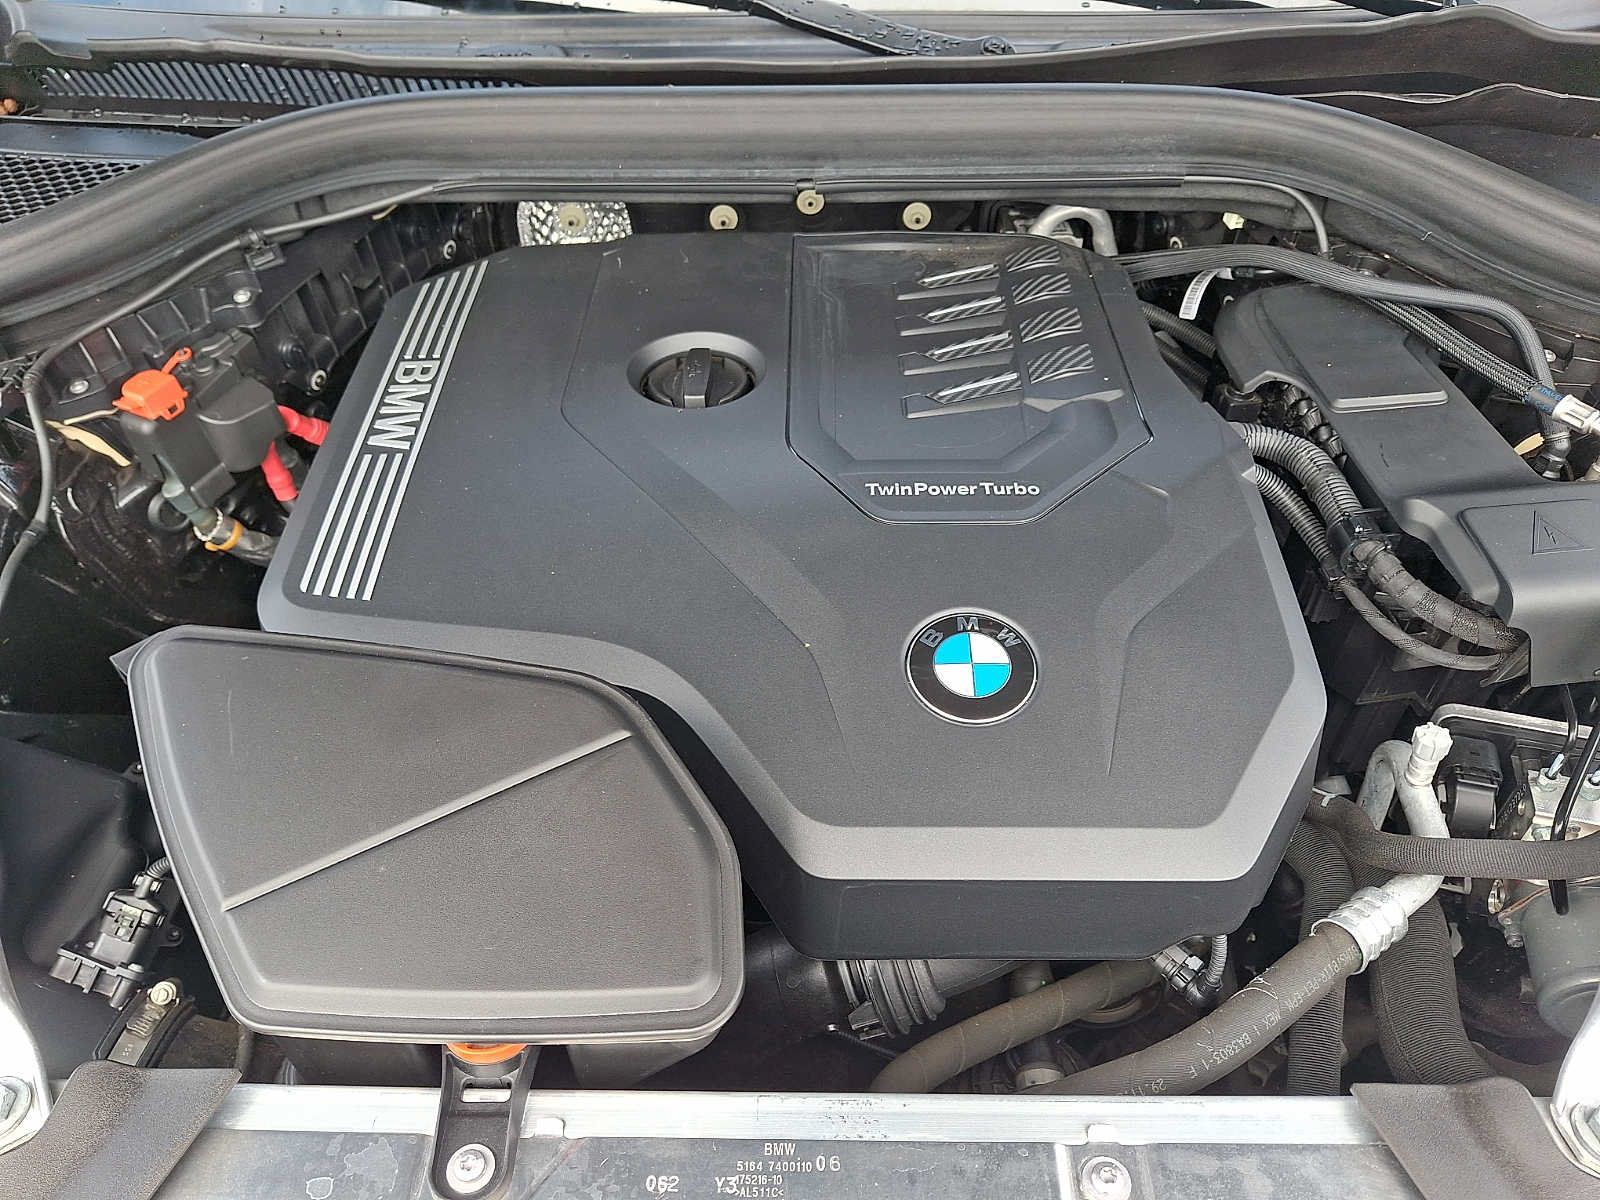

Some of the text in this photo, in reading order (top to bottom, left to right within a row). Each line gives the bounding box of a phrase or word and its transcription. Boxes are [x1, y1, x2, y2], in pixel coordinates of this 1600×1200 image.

[366, 360, 441, 450] BMW
[864, 482, 1040, 496] TwinPower Turbo
[919, 616, 1023, 648] BMW
[764, 1142, 796, 1156] BMW
[736, 1158, 813, 1172] 5164 7400110
